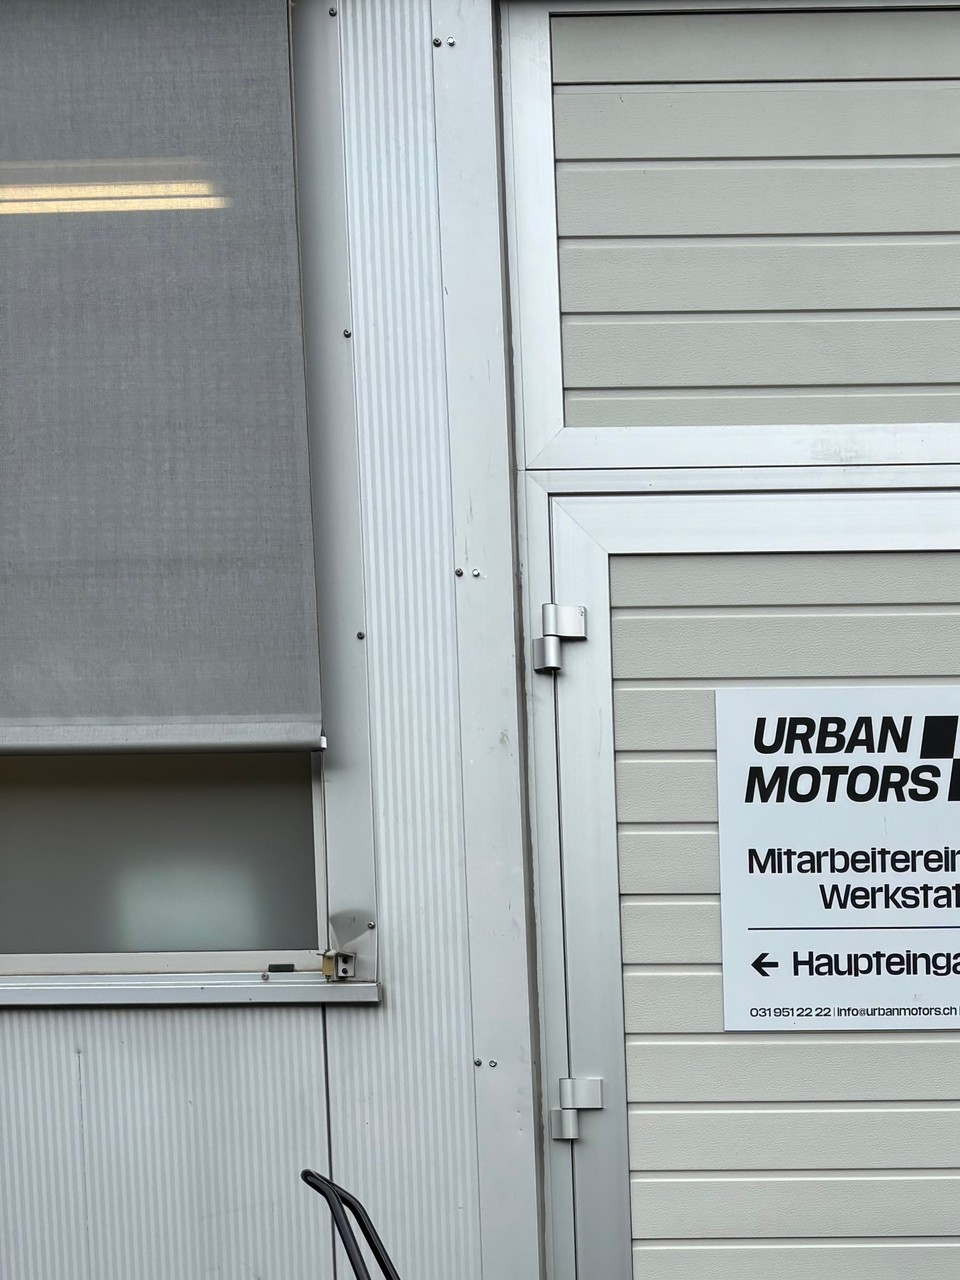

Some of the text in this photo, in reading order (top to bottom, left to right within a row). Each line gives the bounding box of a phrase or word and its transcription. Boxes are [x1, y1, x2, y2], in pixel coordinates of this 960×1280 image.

[753, 715, 913, 755] URBAN
[744, 764, 942, 804] MOTORS
[749, 1007, 772, 1018] 031
[773, 1007, 795, 1018] 951
[796, 1006, 813, 1017] 22
[814, 1006, 832, 1017] 22
